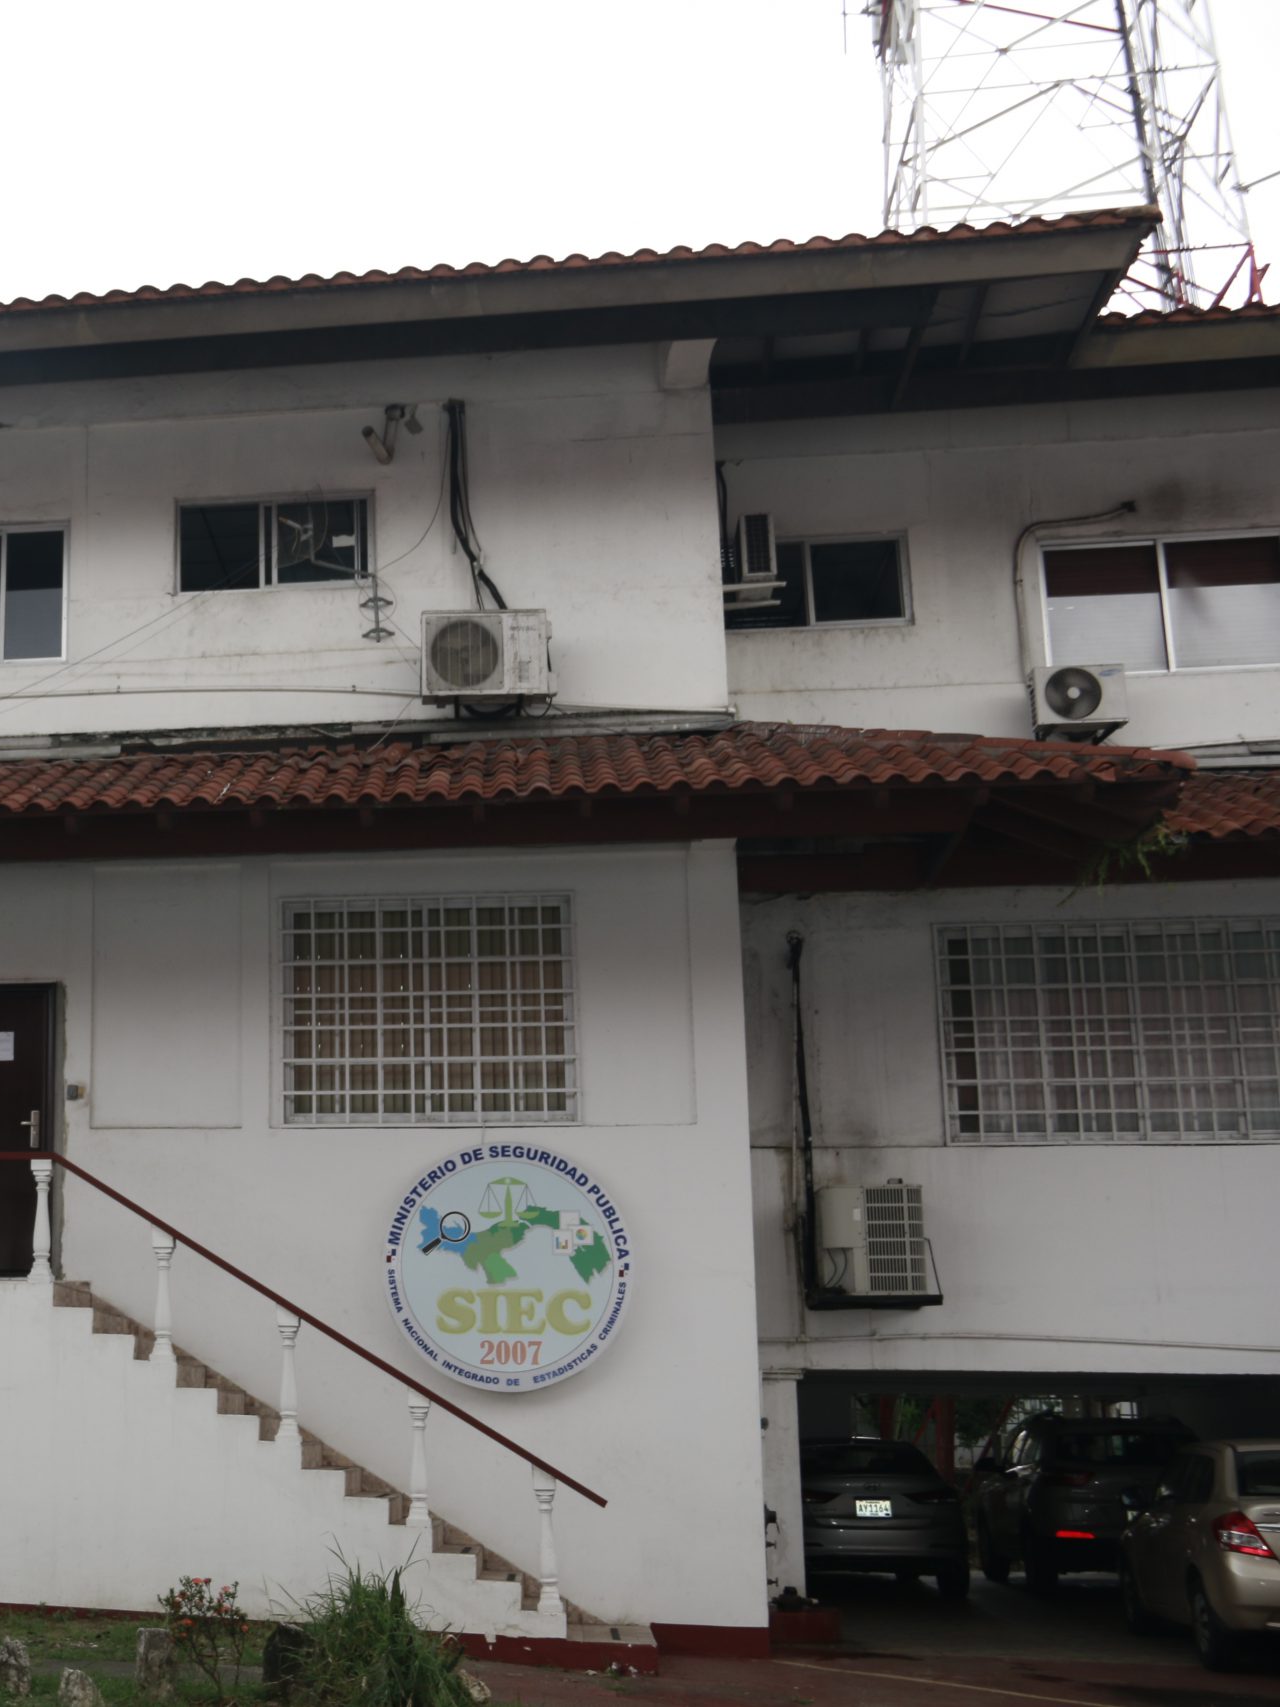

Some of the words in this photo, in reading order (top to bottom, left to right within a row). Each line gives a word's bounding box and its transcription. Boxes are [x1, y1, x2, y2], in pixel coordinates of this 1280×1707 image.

[388, 1159, 457, 1246] MINISTERIO
[460, 1148, 484, 1165] DE
[489, 1145, 589, 1187] SEGURIDAD
[587, 1184, 630, 1260] PUBLICA
[387, 1268, 403, 1313] SISTEMA
[402, 1317, 438, 1362] NACIONAL
[442, 1360, 500, 1385] INTEGRADO
[506, 1378, 520, 1387] DE
[533, 1343, 598, 1384] ESTADISTICAS
[598, 1281, 627, 1341] CRIMINALES
[436, 1288, 592, 1335] SIEC
[479, 1340, 543, 1365] 2007
